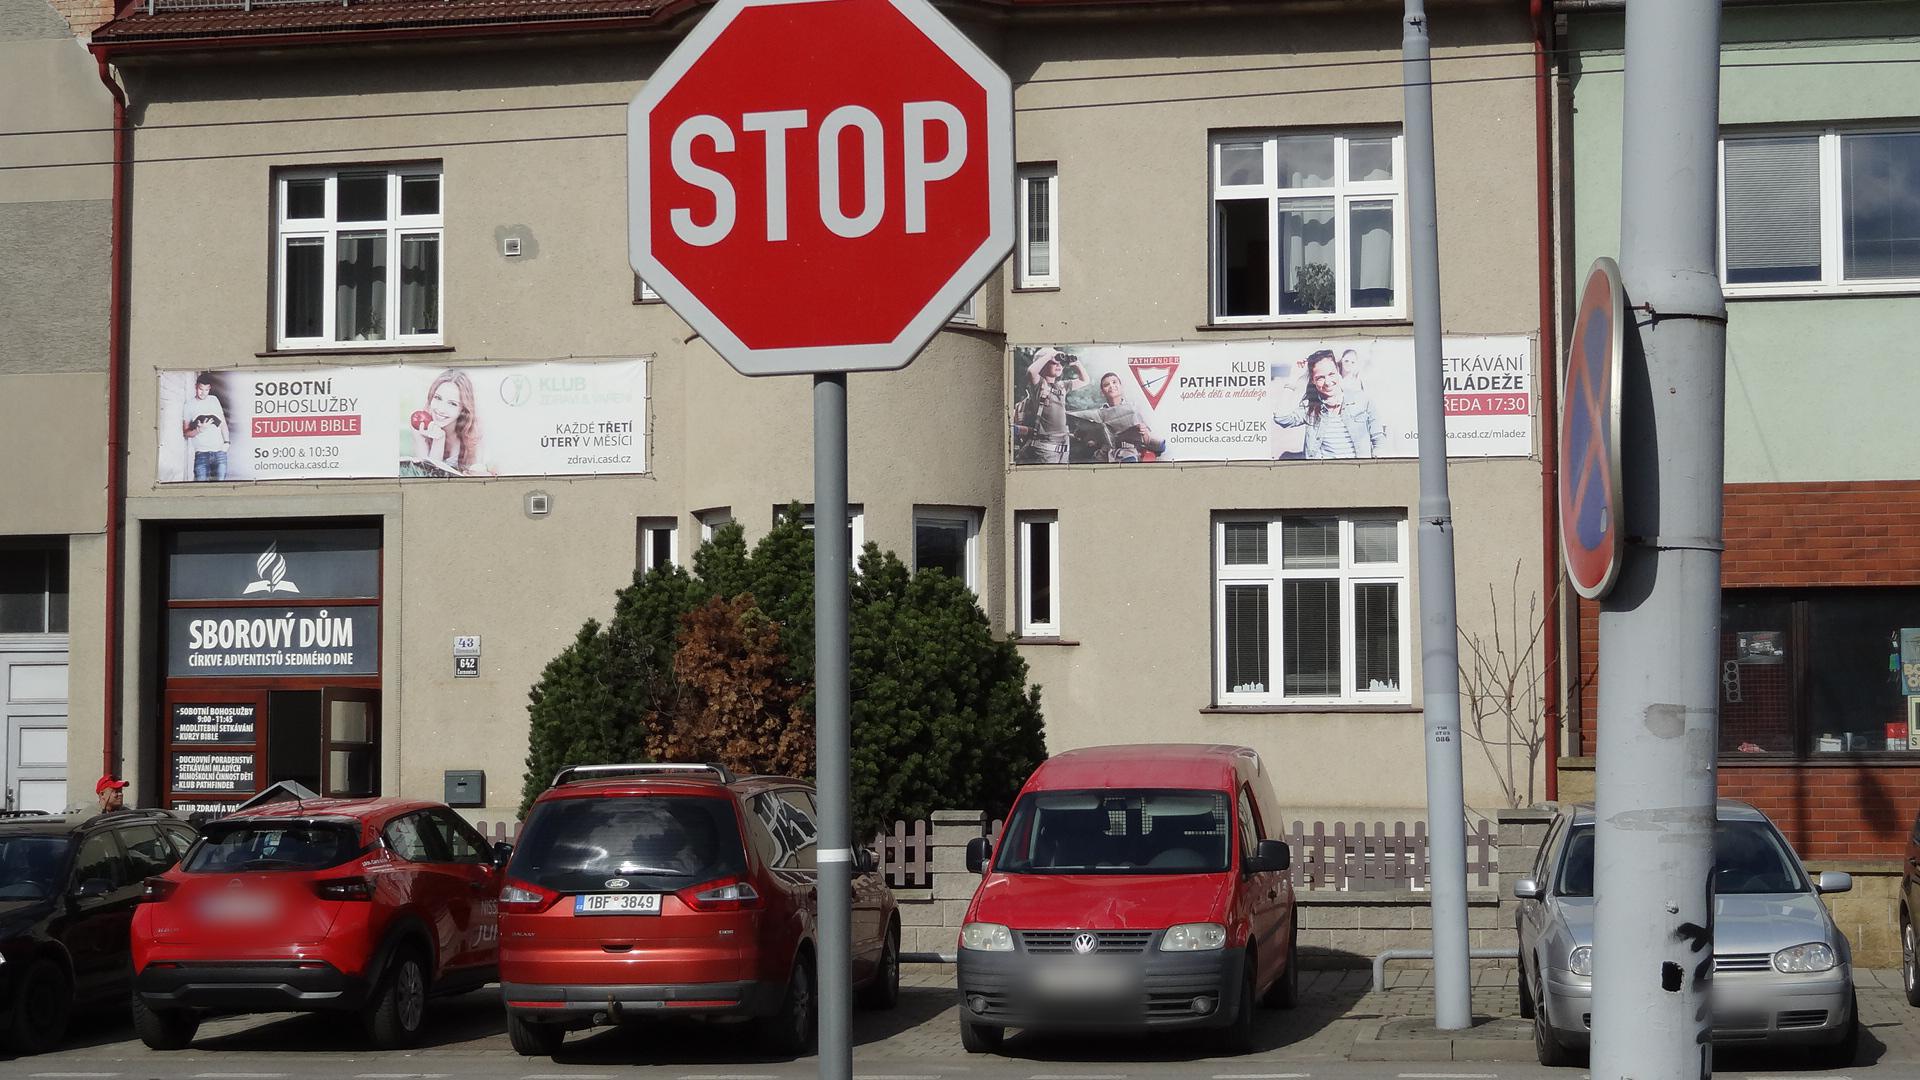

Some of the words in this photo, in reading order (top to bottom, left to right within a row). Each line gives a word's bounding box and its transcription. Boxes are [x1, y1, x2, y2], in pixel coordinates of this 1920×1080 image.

[670, 100, 968, 247] STOP
[1128, 356, 1180, 364] PATHFINDER
[1442, 354, 1524, 373] ETKÁVÁNÍ
[1231, 361, 1266, 373] KLUB
[255, 378, 332, 397] SOBOTNÍ
[1180, 375, 1266, 388] PATHFINDER
[1180, 390, 1206, 401] spolek
[1223, 391, 1231, 399] a
[255, 396, 358, 414] BOHOSLUŽBY
[1444, 396, 1482, 411] ŘEDA
[1487, 397, 1525, 411] 17:30
[255, 420, 317, 434] STUDIUM
[320, 419, 357, 432] BIBLE
[556, 422, 595, 434] KAŽDÉ
[598, 420, 632, 433] TŘETÍ
[1171, 422, 1213, 432] ROZPIS
[1215, 420, 1267, 432] SCHŮZEK
[541, 434, 580, 448] ÚTERÝ
[583, 437, 592, 447] V
[594, 434, 633, 447] MĚSÍCI
[1170, 434, 1267, 444] olomoucka.casd.cz/kp
[255, 447, 270, 459] So
[272, 447, 296, 458] 9:00
[298, 448, 305, 458] &
[309, 446, 339, 457] 10:30
[255, 460, 340, 471] olomoucka.casd.cz
[567, 454, 631, 465] zdravi.casd.cz
[189, 612, 296, 649] SBOROVÝ
[300, 609, 353, 647] DŮM
[458, 637, 474, 648] 43
[189, 652, 223, 667] CÍRKVE
[224, 650, 283, 666] ADVENTISTŮ
[285, 650, 332, 665] SEDMÉHO
[334, 652, 353, 665] DNE
[460, 658, 475, 668] 642
[180, 706, 209, 716] SOBOTNÍ
[210, 706, 254, 716] BOHOSLUŽBY
[180, 723, 218, 732] MODLITEBNÍ
[219, 723, 254, 732] SETKÁVÁNÍ
[179, 755, 211, 764] DUCHOVNÍ
[211, 755, 253, 764] PORADENSTVÍ
[179, 763, 212, 772] SETKÁVÁNÍ
[240, 771, 254, 780] DĚTÍ
[179, 781, 195, 789] KLUB
[196, 781, 235, 789] PATHFINDER
[197, 803, 221, 812] ZDRAVÍ
[588, 896, 611, 909] 1BF
[621, 896, 654, 908] 3849
